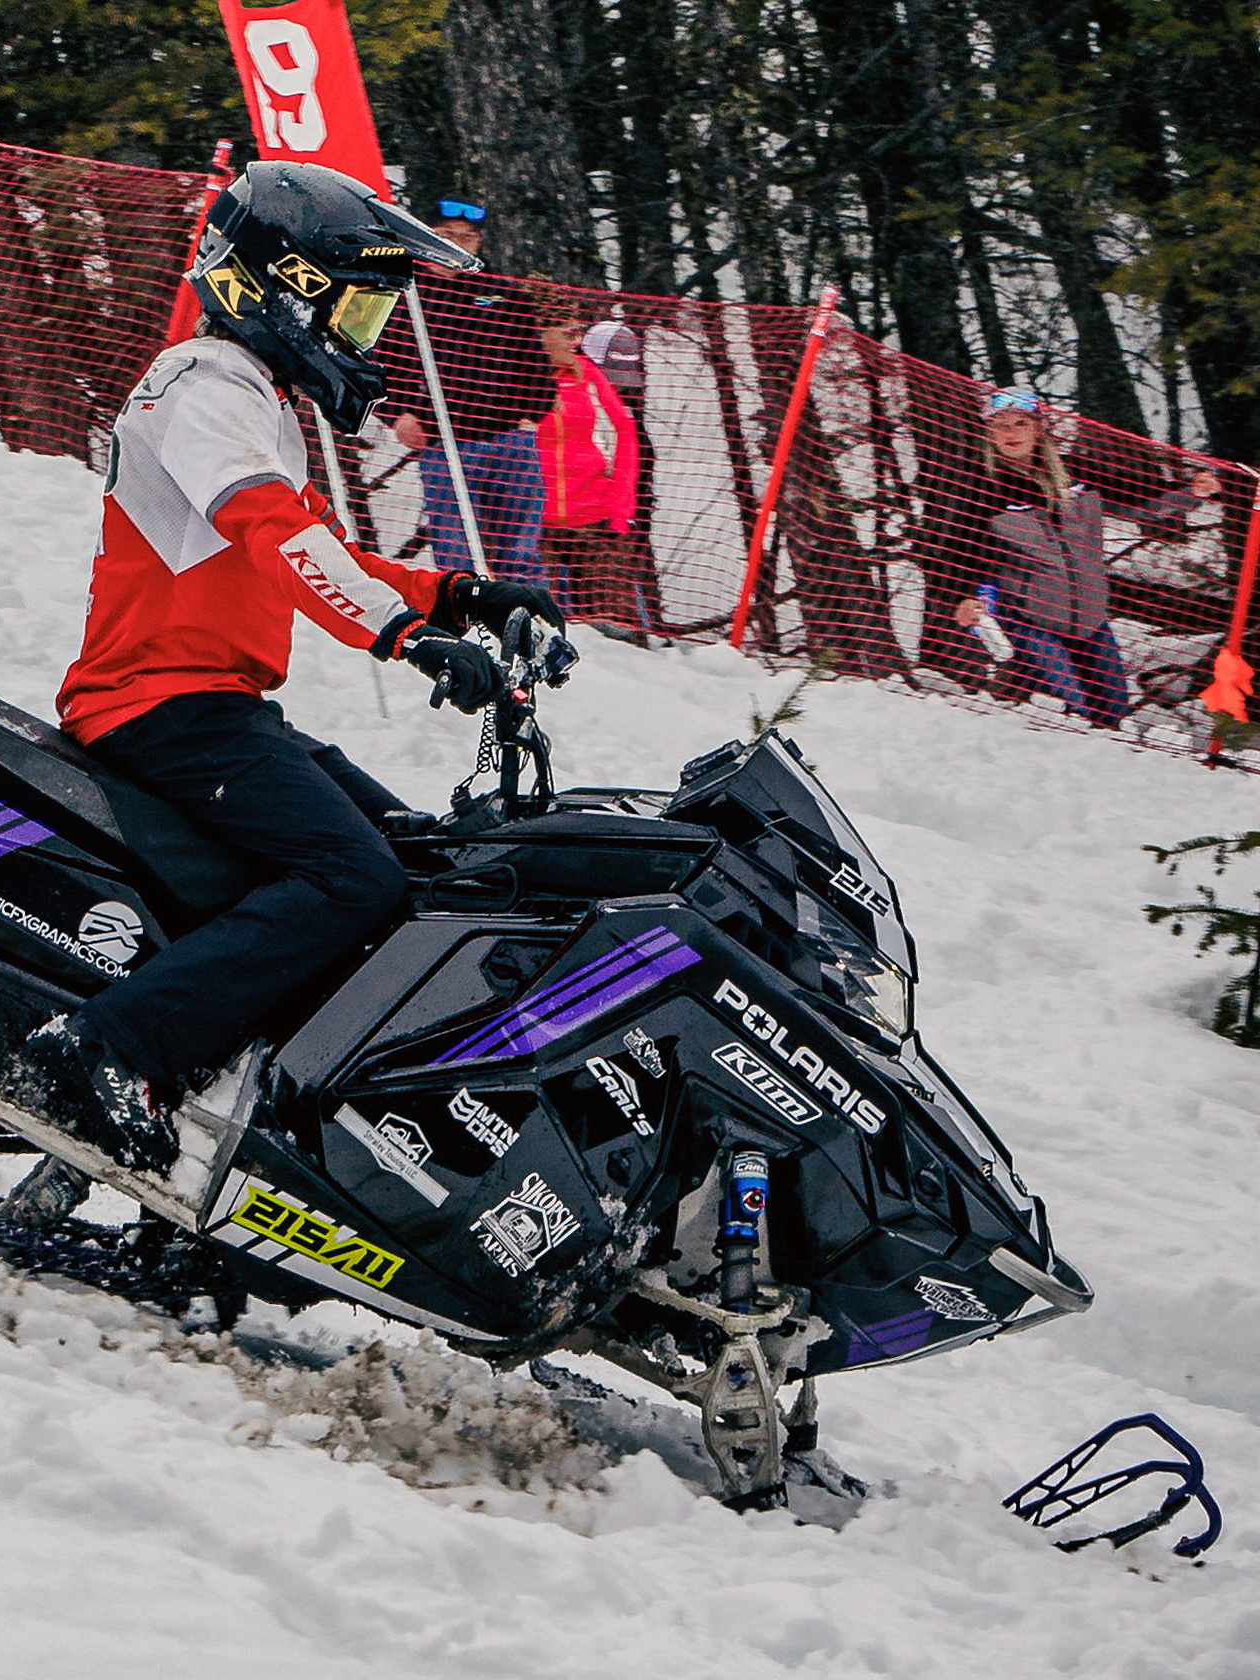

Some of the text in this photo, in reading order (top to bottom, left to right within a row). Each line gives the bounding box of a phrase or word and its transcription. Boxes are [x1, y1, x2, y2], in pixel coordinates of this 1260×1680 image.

[830, 863, 892, 918] 215
[713, 978, 887, 1135] POLARIS
[475, 1105, 520, 1147] MTN
[585, 1056, 656, 1136] CARL'S
[465, 1117, 509, 1158] OPS
[404, 1165, 418, 1180] LLC
[239, 1191, 398, 1284] 215/11
[510, 1171, 581, 1248] SIKORSKI
